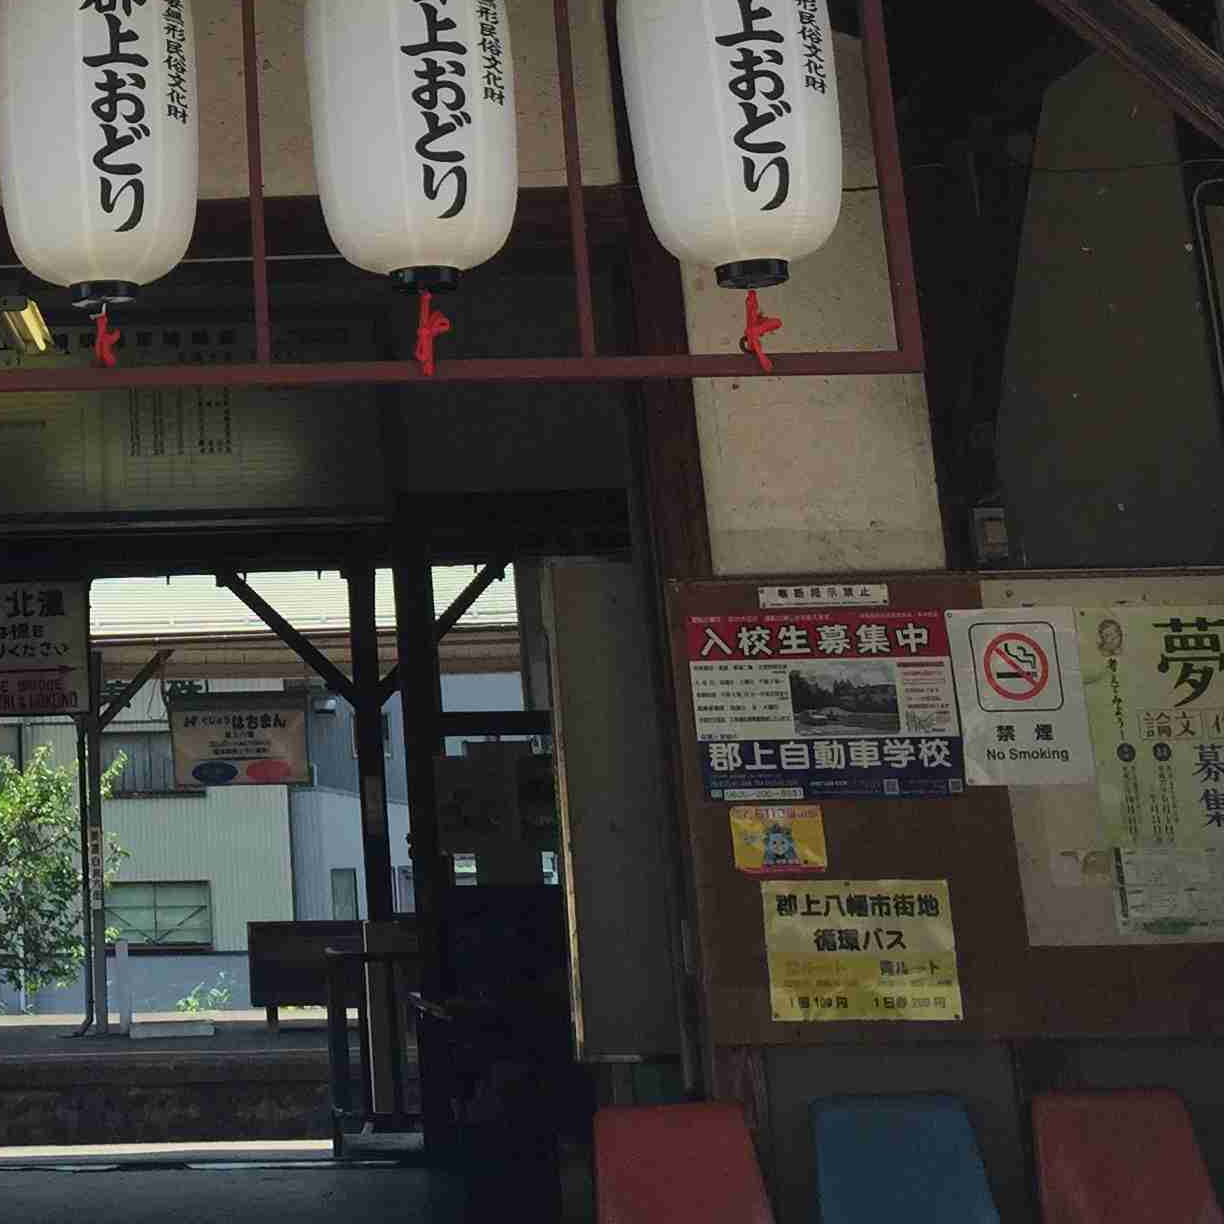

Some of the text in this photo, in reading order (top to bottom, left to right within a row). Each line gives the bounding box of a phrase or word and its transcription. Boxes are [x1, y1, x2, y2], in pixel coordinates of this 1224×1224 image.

[700, 624, 929, 657] 入校生募集中
[995, 723, 1055, 742] 禁煙
[1143, 711, 1196, 739] 論文
[708, 738, 953, 772] 郡上自動車学校
[987, 747, 1070, 762] No Smoking
[776, 893, 940, 918] 郡上八幡市街地
[813, 928, 907, 952] 循環バス
